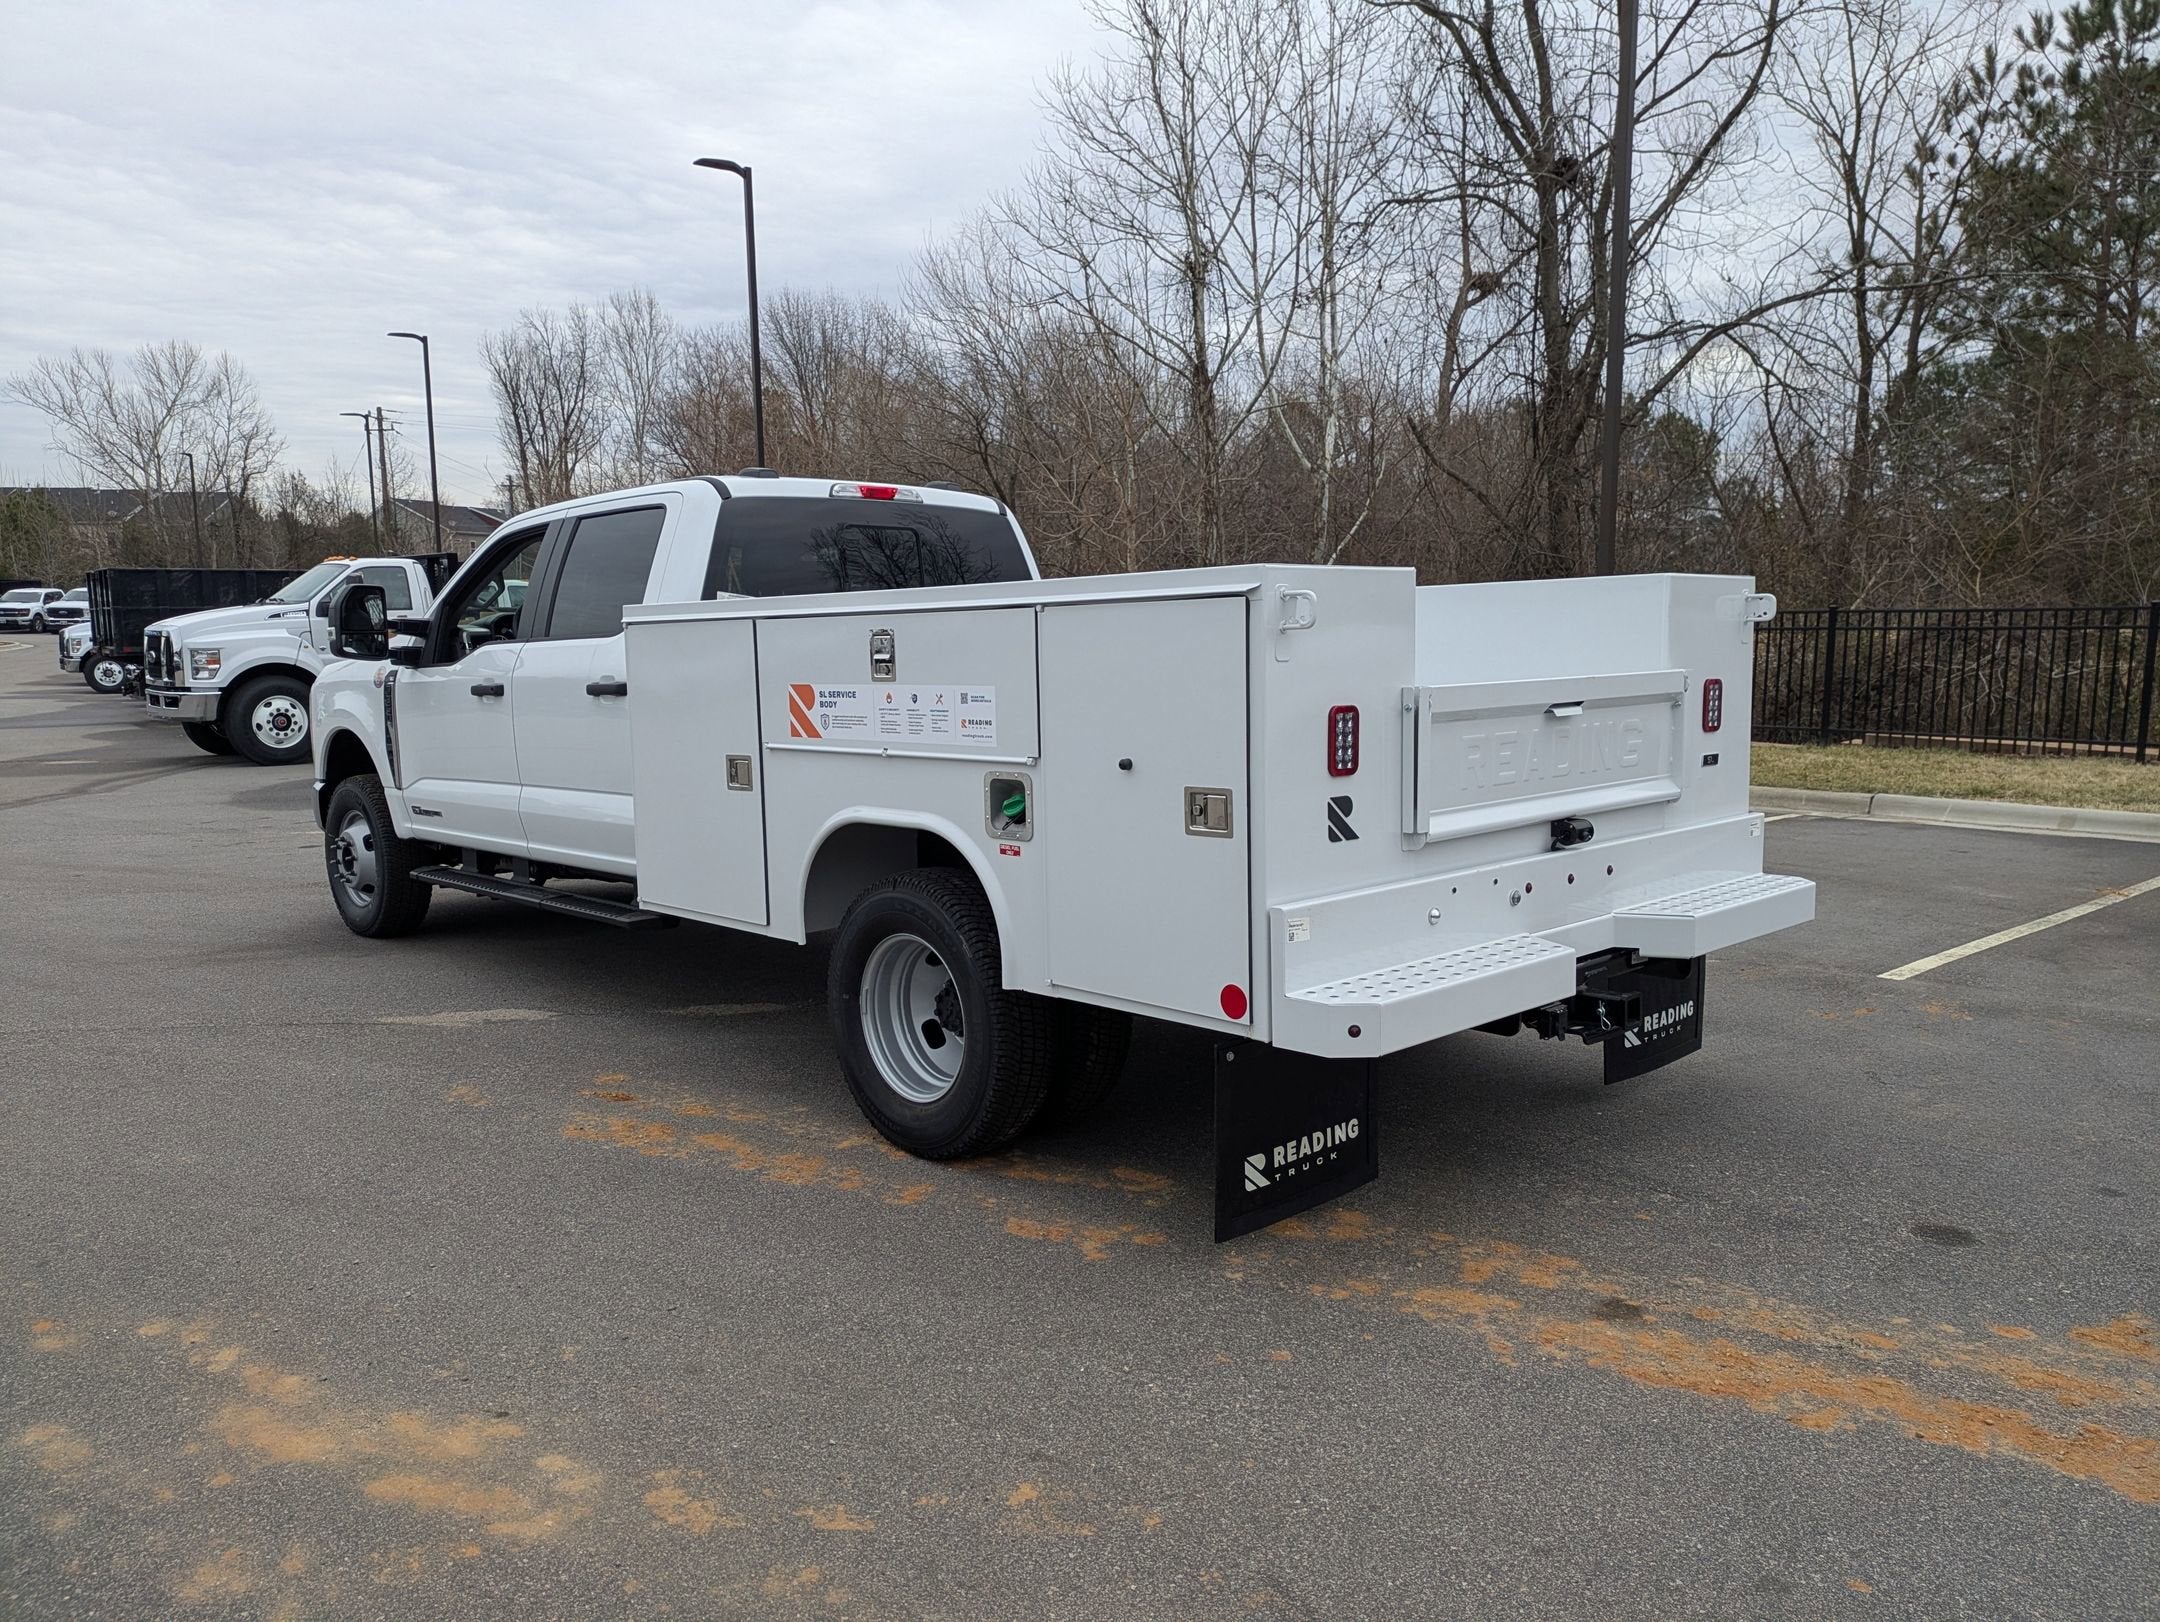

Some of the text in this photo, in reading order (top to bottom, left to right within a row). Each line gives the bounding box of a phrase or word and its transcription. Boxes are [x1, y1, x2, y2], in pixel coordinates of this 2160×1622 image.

[819, 690, 857, 699] SL SERVICE
[819, 701, 838, 709] BODY
[1460, 718, 1643, 791] READING
[1643, 1000, 1694, 1032] READING
[1644, 1024, 1682, 1043] TRUCK
[1273, 1118, 1359, 1168] READING
[1274, 1151, 1337, 1182] TRUCK
